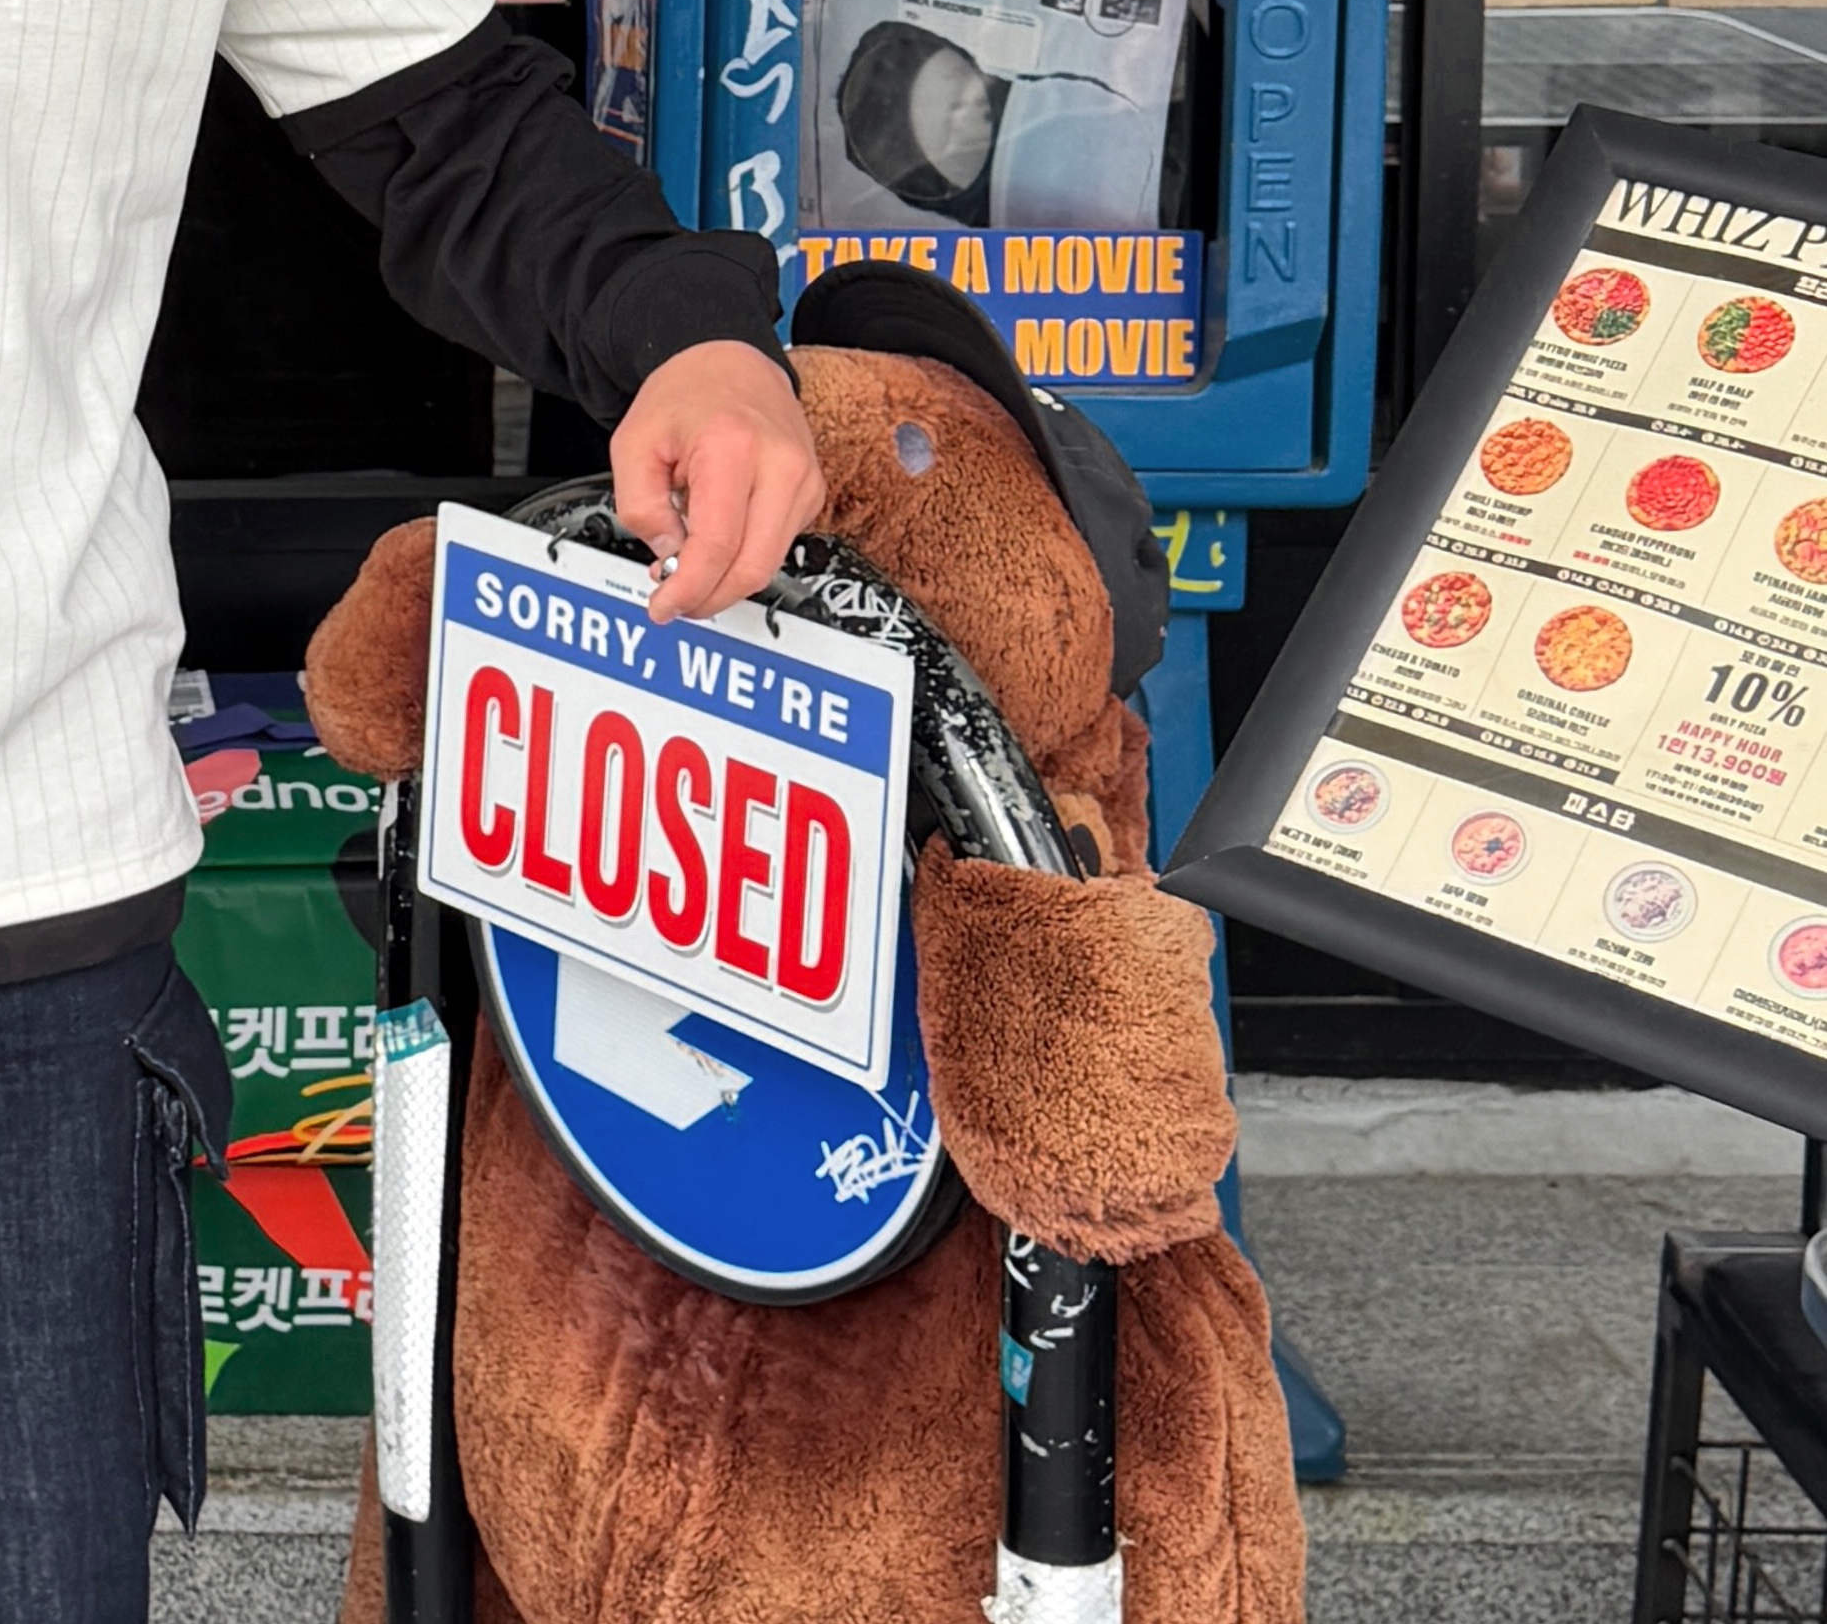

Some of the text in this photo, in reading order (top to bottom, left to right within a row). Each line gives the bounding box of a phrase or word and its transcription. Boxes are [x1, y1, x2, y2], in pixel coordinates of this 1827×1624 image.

[1619, 179, 1827, 270] WHIZ P
[951, 236, 990, 293] A
[1004, 235, 1184, 294] MOVIE
[1015, 318, 1194, 377] MOVIE
[474, 570, 850, 743] SORRY, WE'RE
[1416, 654, 1461, 679] TOMATO
[1704, 664, 1809, 727] 10%
[1677, 720, 1784, 763] HAPPY HOUR
[1737, 721, 1767, 737] PIZZA
[1657, 734, 1688, 756] 1인
[1691, 745, 1788, 787] 13,900원
[459, 664, 853, 1005] CLOSED
[1562, 793, 1636, 831] 파스타
[210, 1006, 376, 1078] 켓프
